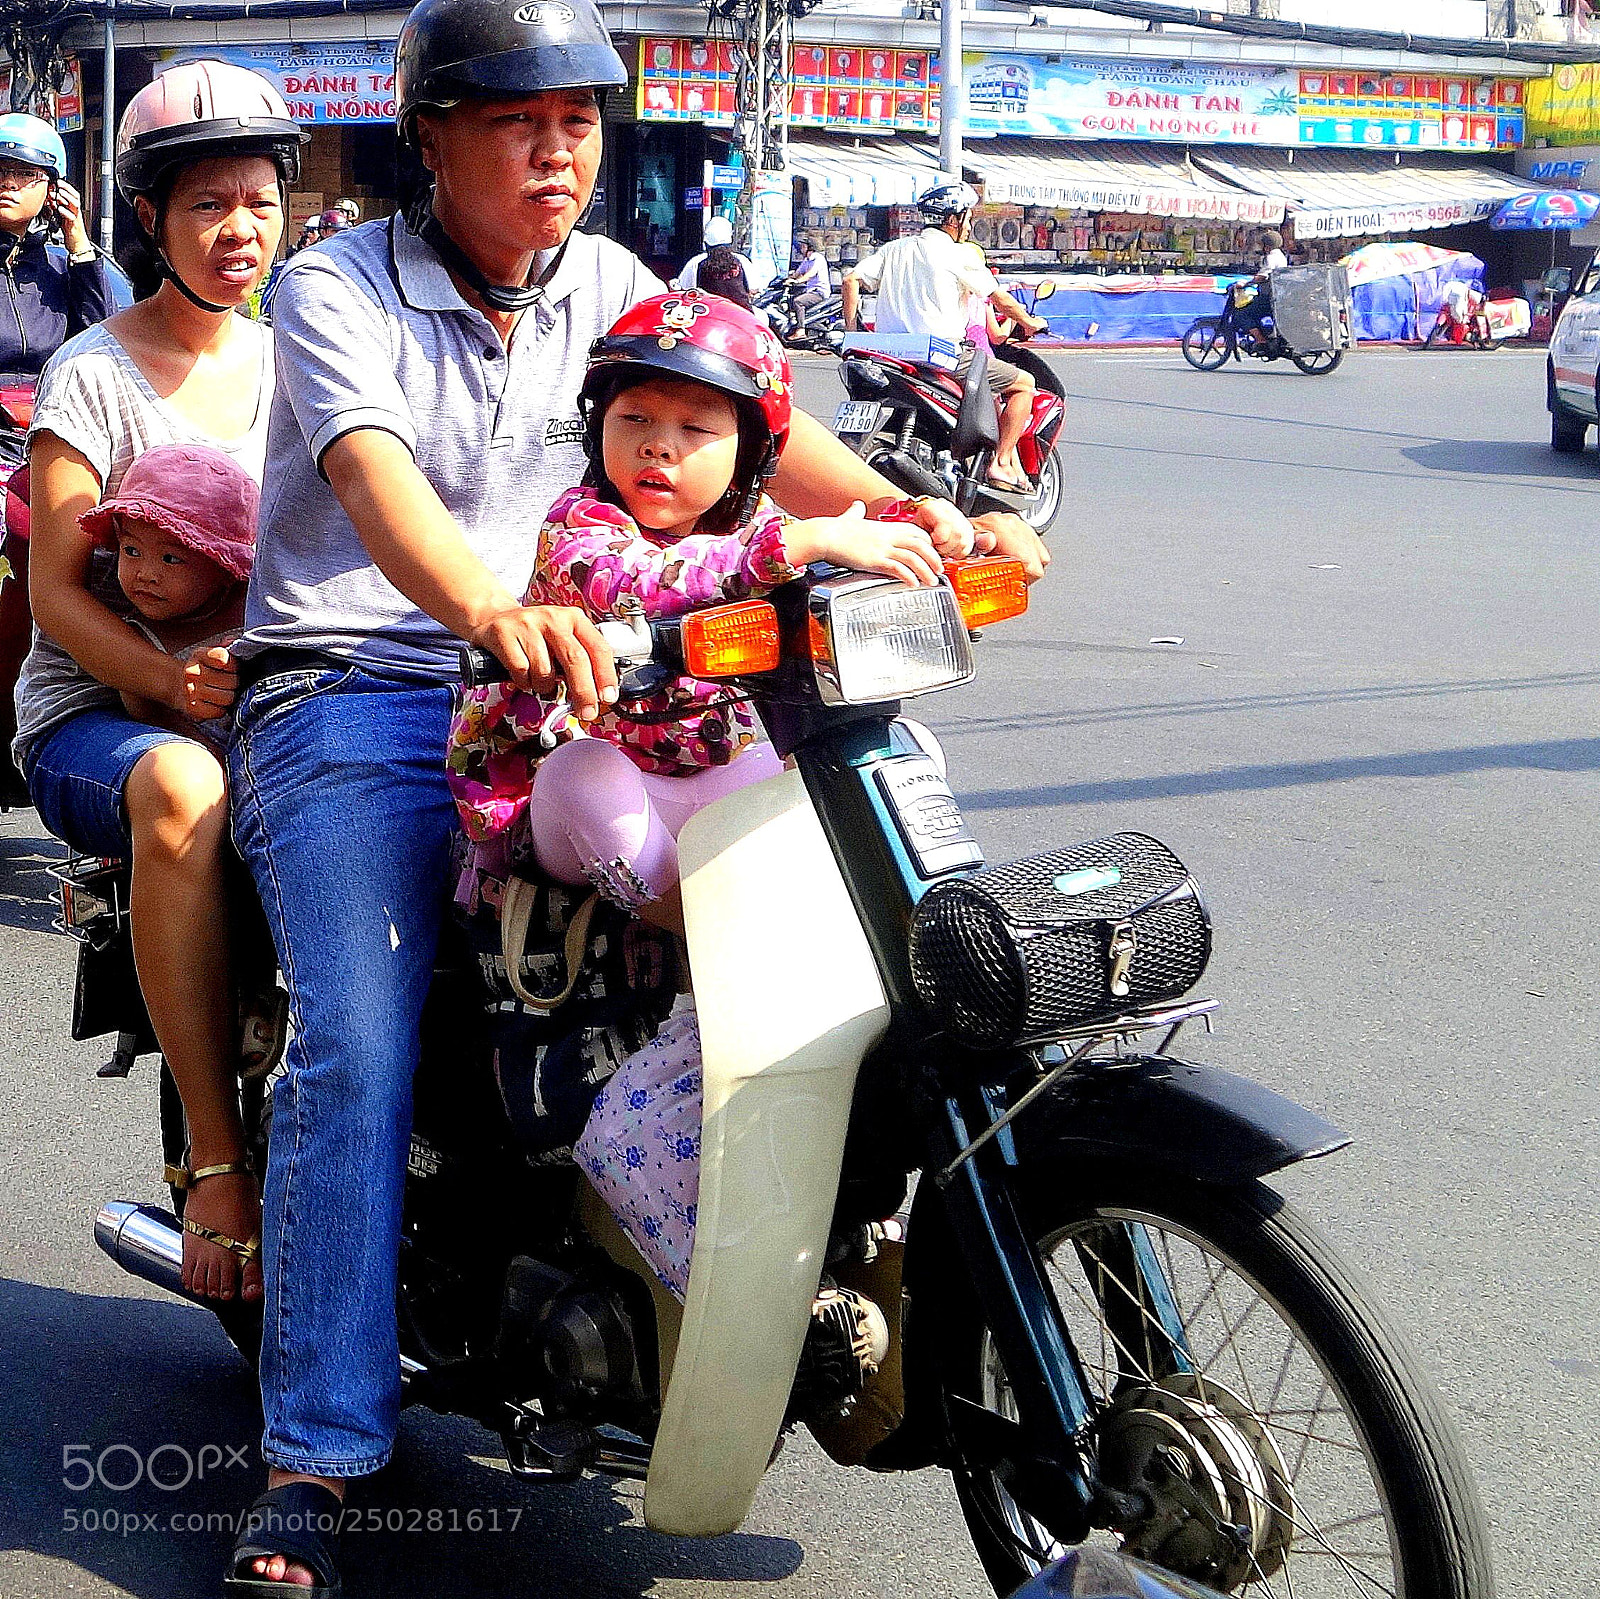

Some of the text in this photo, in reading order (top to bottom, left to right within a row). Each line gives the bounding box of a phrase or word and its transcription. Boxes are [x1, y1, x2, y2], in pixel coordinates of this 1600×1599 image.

[284, 71, 396, 94] ĐÁNH TA
[1106, 87, 1241, 112] ĐÁNH TAN
[1008, 184, 1036, 199] TRUNG
[843, 403, 871, 416] 59-Y1
[834, 416, 872, 430] 701.90
